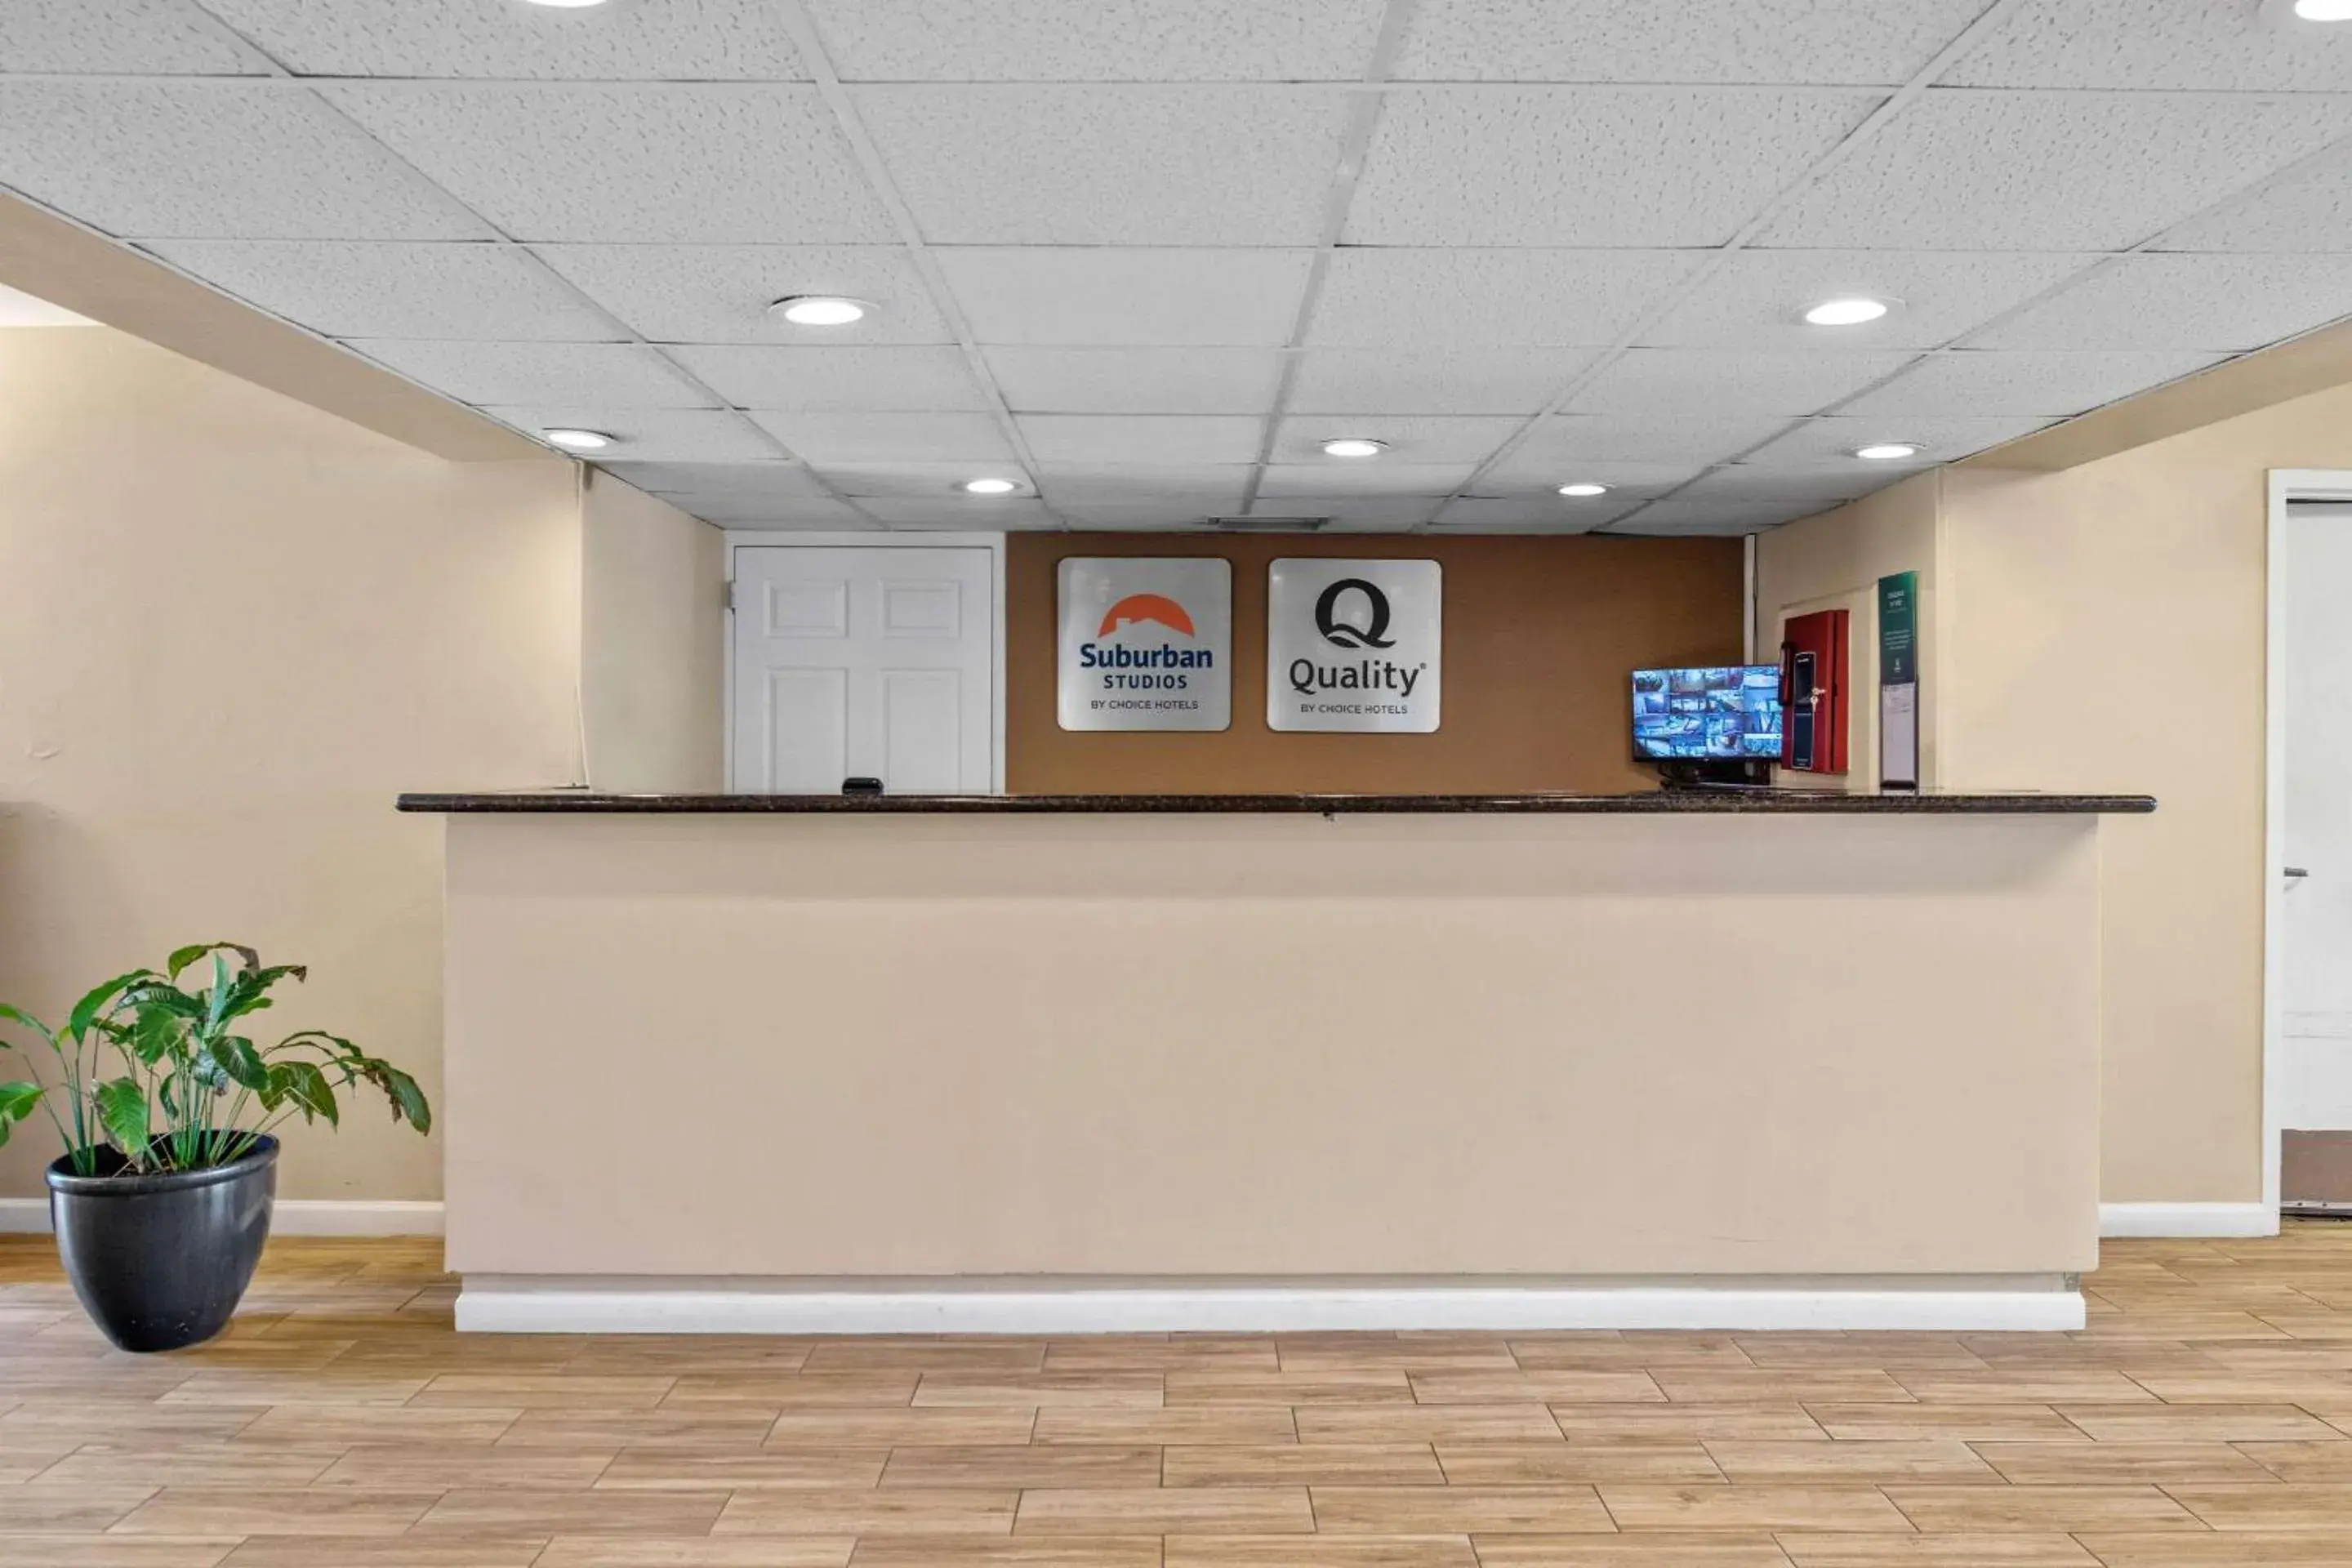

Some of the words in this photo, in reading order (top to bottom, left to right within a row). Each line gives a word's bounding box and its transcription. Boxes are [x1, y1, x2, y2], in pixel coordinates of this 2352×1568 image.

[1080, 644, 1213, 668] Suburban
[1103, 675, 1187, 689] STUDIOS
[1091, 700, 1106, 710] BY
[1109, 700, 1152, 710] CHOICE
[1155, 700, 1199, 710] HOTELS
[1300, 704, 1316, 714] BY
[1318, 704, 1361, 715] CHOICE
[1365, 704, 1407, 715] HOTELS
